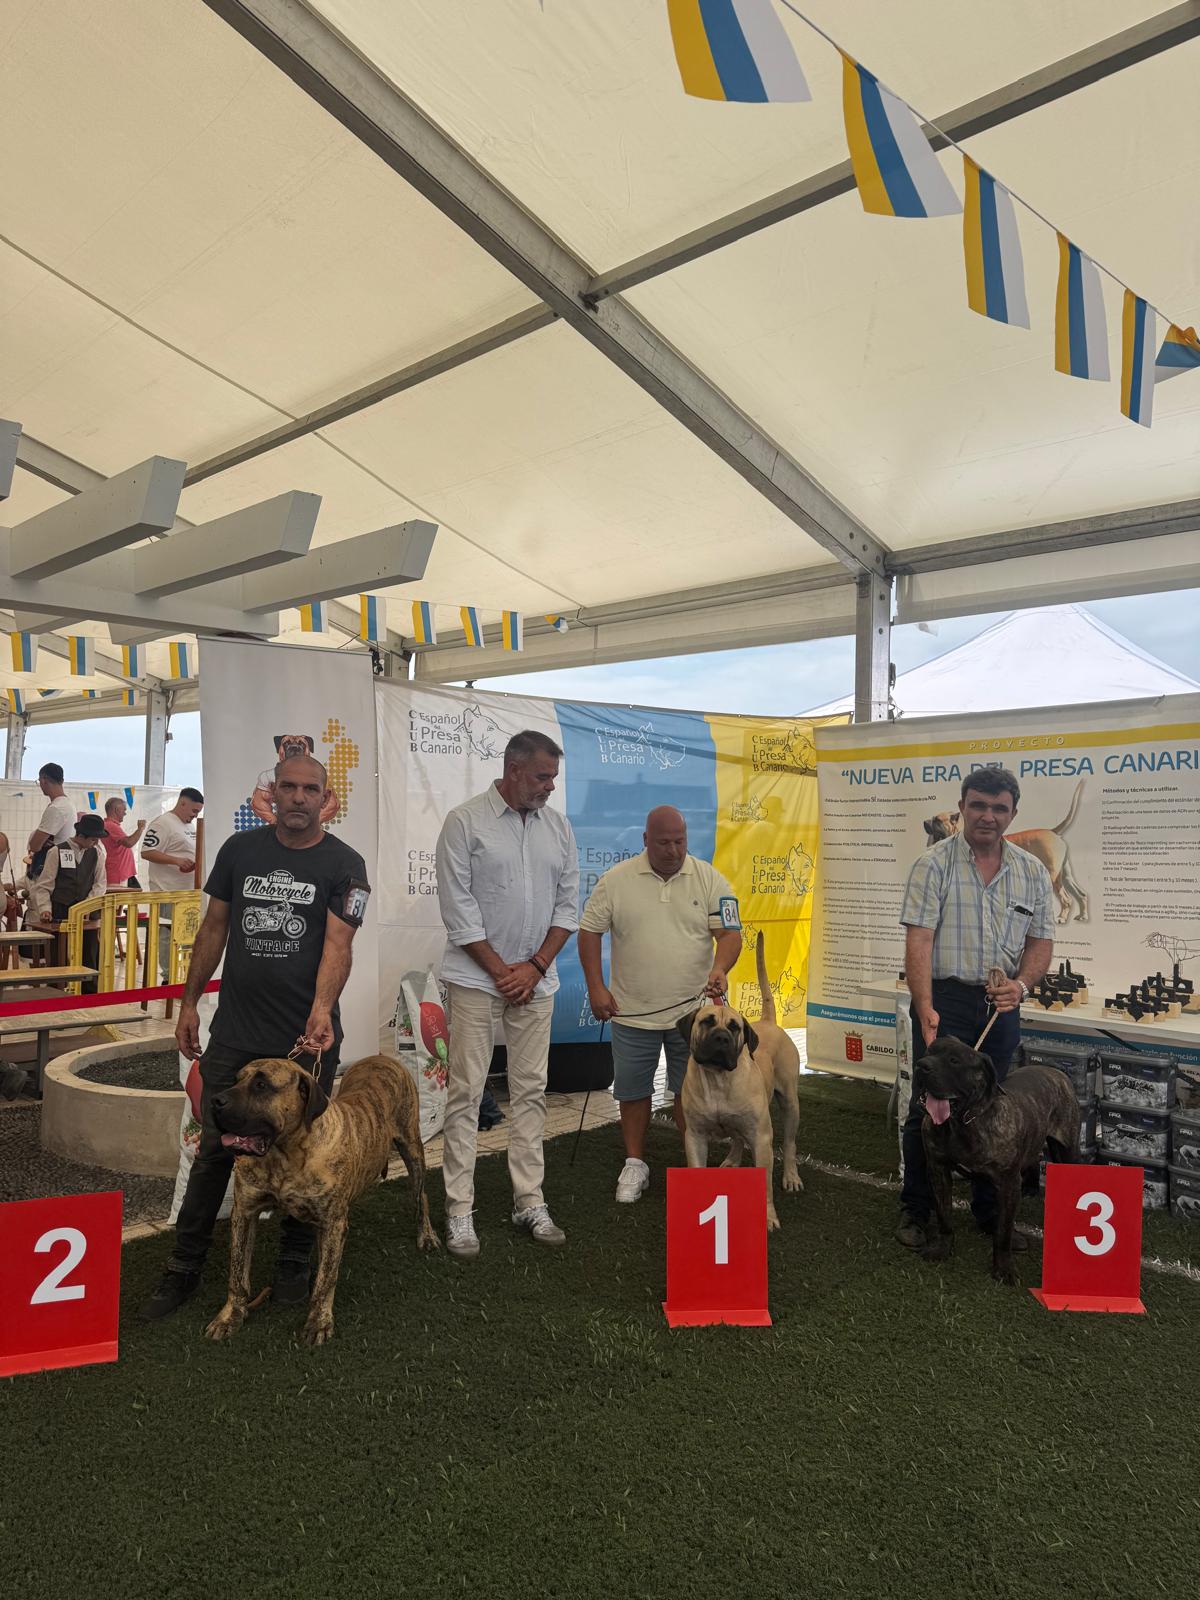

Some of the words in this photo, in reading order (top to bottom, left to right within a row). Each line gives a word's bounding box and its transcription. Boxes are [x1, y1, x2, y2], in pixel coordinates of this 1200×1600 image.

[419, 712, 461, 725] Español
[421, 726, 461, 742] Presa
[604, 727, 640, 738] Español
[420, 740, 463, 755] Canario
[608, 740, 644, 753] Presa
[759, 735, 787, 747] Español
[968, 736, 1065, 751] PROYECTO
[609, 751, 646, 765] Canario
[759, 749, 787, 761] Presa
[922, 765, 962, 783] ERA
[1020, 756, 1094, 779] PRESA
[760, 855, 788, 866] Español
[269, 875, 293, 885] ENGINE
[759, 869, 787, 882] Presa
[245, 876, 312, 900] Motorcycle
[758, 882, 786, 895] Canario
[245, 937, 300, 953] VINTAGE
[865, 1044, 894, 1054] CABILDO
[698, 1195, 729, 1265] 1
[1073, 1191, 1117, 1256] 3
[30, 1227, 87, 1305] 2
